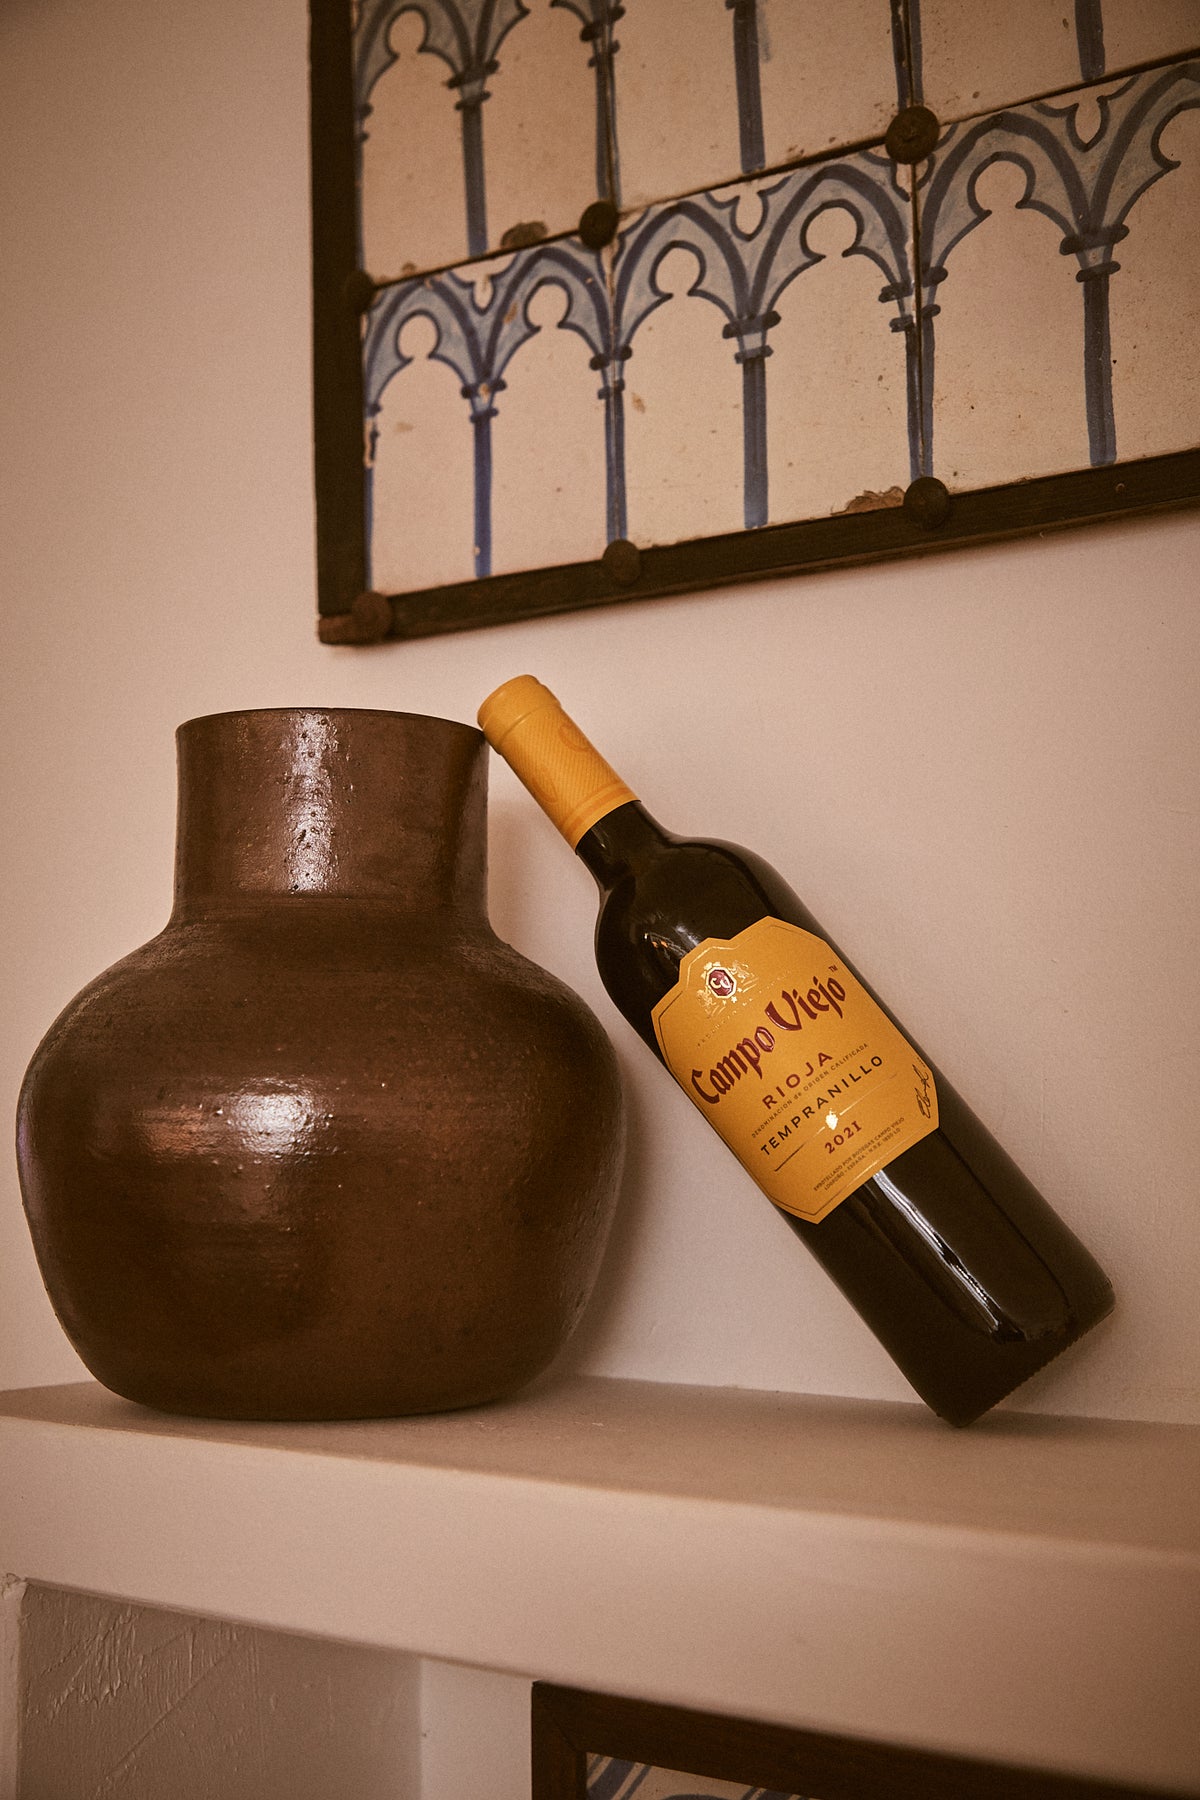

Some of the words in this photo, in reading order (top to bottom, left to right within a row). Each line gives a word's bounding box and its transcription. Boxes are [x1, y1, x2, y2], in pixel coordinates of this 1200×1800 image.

[691, 1026, 775, 1104] Campo
[764, 976, 846, 1031] Viejo
[803, 1070, 829, 1092] ORIGEN
[830, 1043, 869, 1070] CALIFICADA
[760, 1055, 883, 1156] TEMPRANILLO
[762, 1052, 833, 1110] RIOJA
[824, 1120, 862, 1154] 2021
